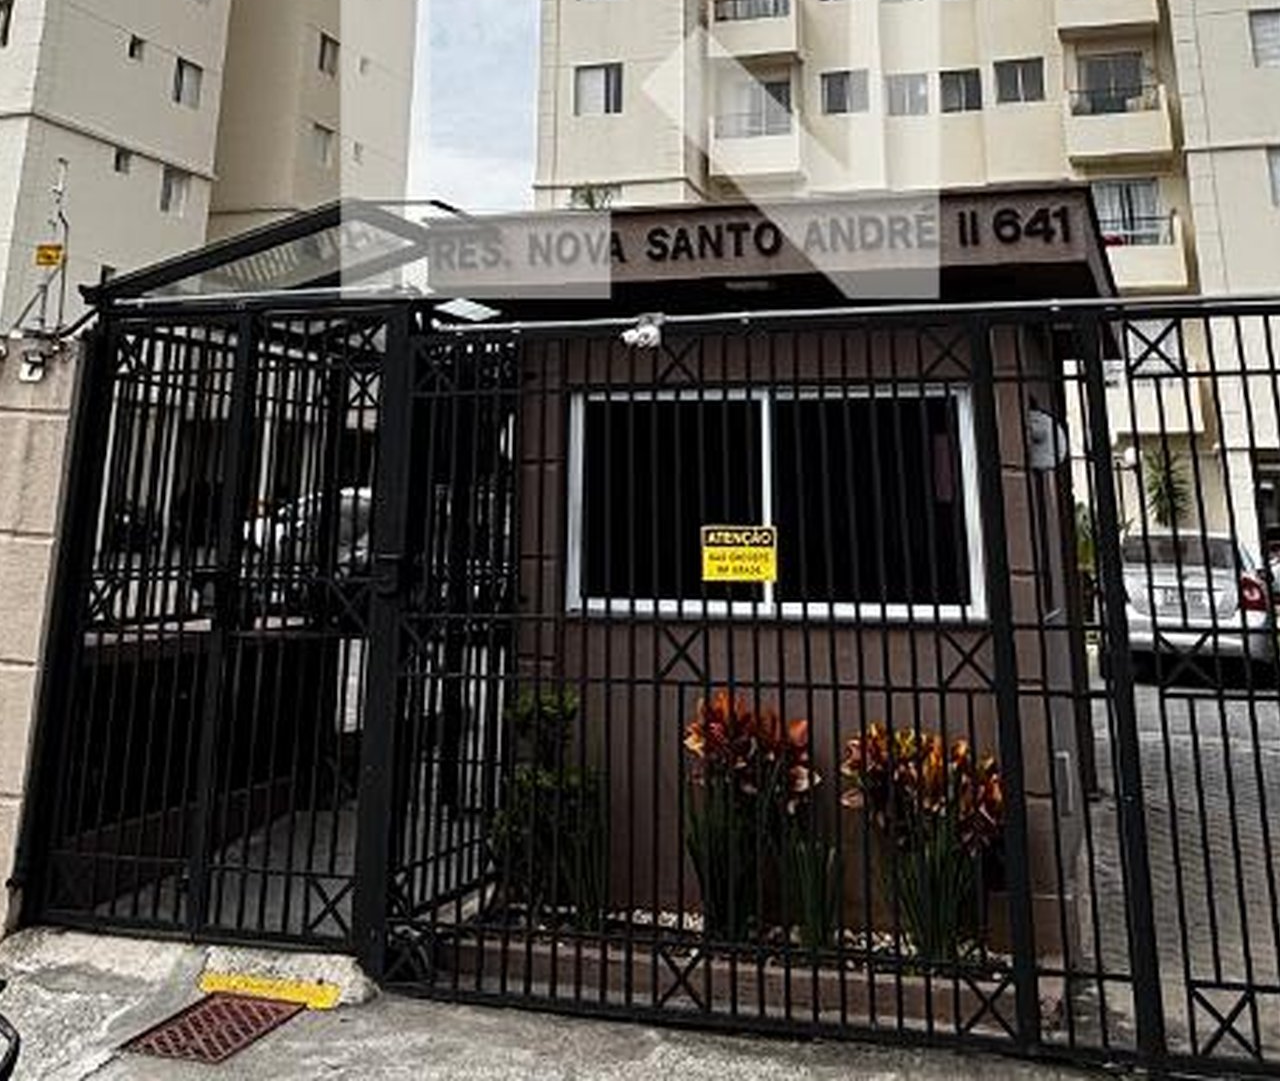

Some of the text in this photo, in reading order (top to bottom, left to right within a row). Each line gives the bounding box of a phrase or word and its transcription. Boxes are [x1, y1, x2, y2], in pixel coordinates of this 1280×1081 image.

[432, 236, 511, 271] RES.
[528, 230, 626, 266] NOVA
[646, 223, 783, 261] SANTO
[804, 208, 937, 253] ANDRÉ
[993, 206, 1070, 244] 641
[707, 529, 772, 546] ATENÇÃO
